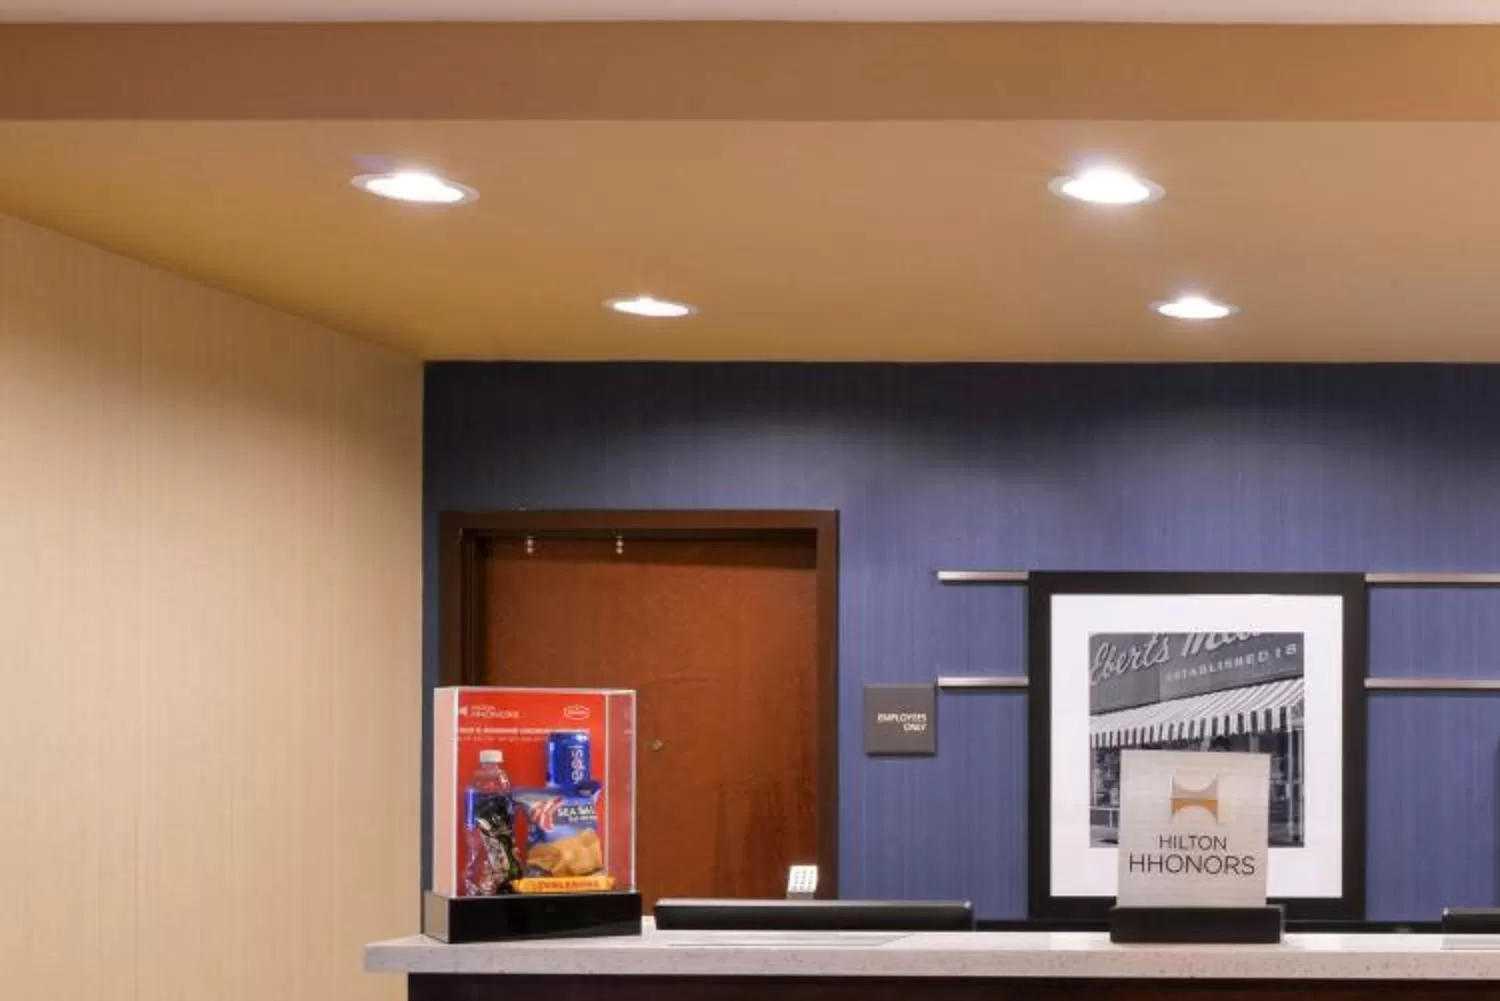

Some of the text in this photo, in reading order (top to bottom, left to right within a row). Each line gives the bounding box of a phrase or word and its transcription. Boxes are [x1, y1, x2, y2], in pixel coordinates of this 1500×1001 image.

[903, 723, 927, 731] ONLY
[1159, 834, 1227, 851] HILTON
[1129, 853, 1255, 875] HHONORS
